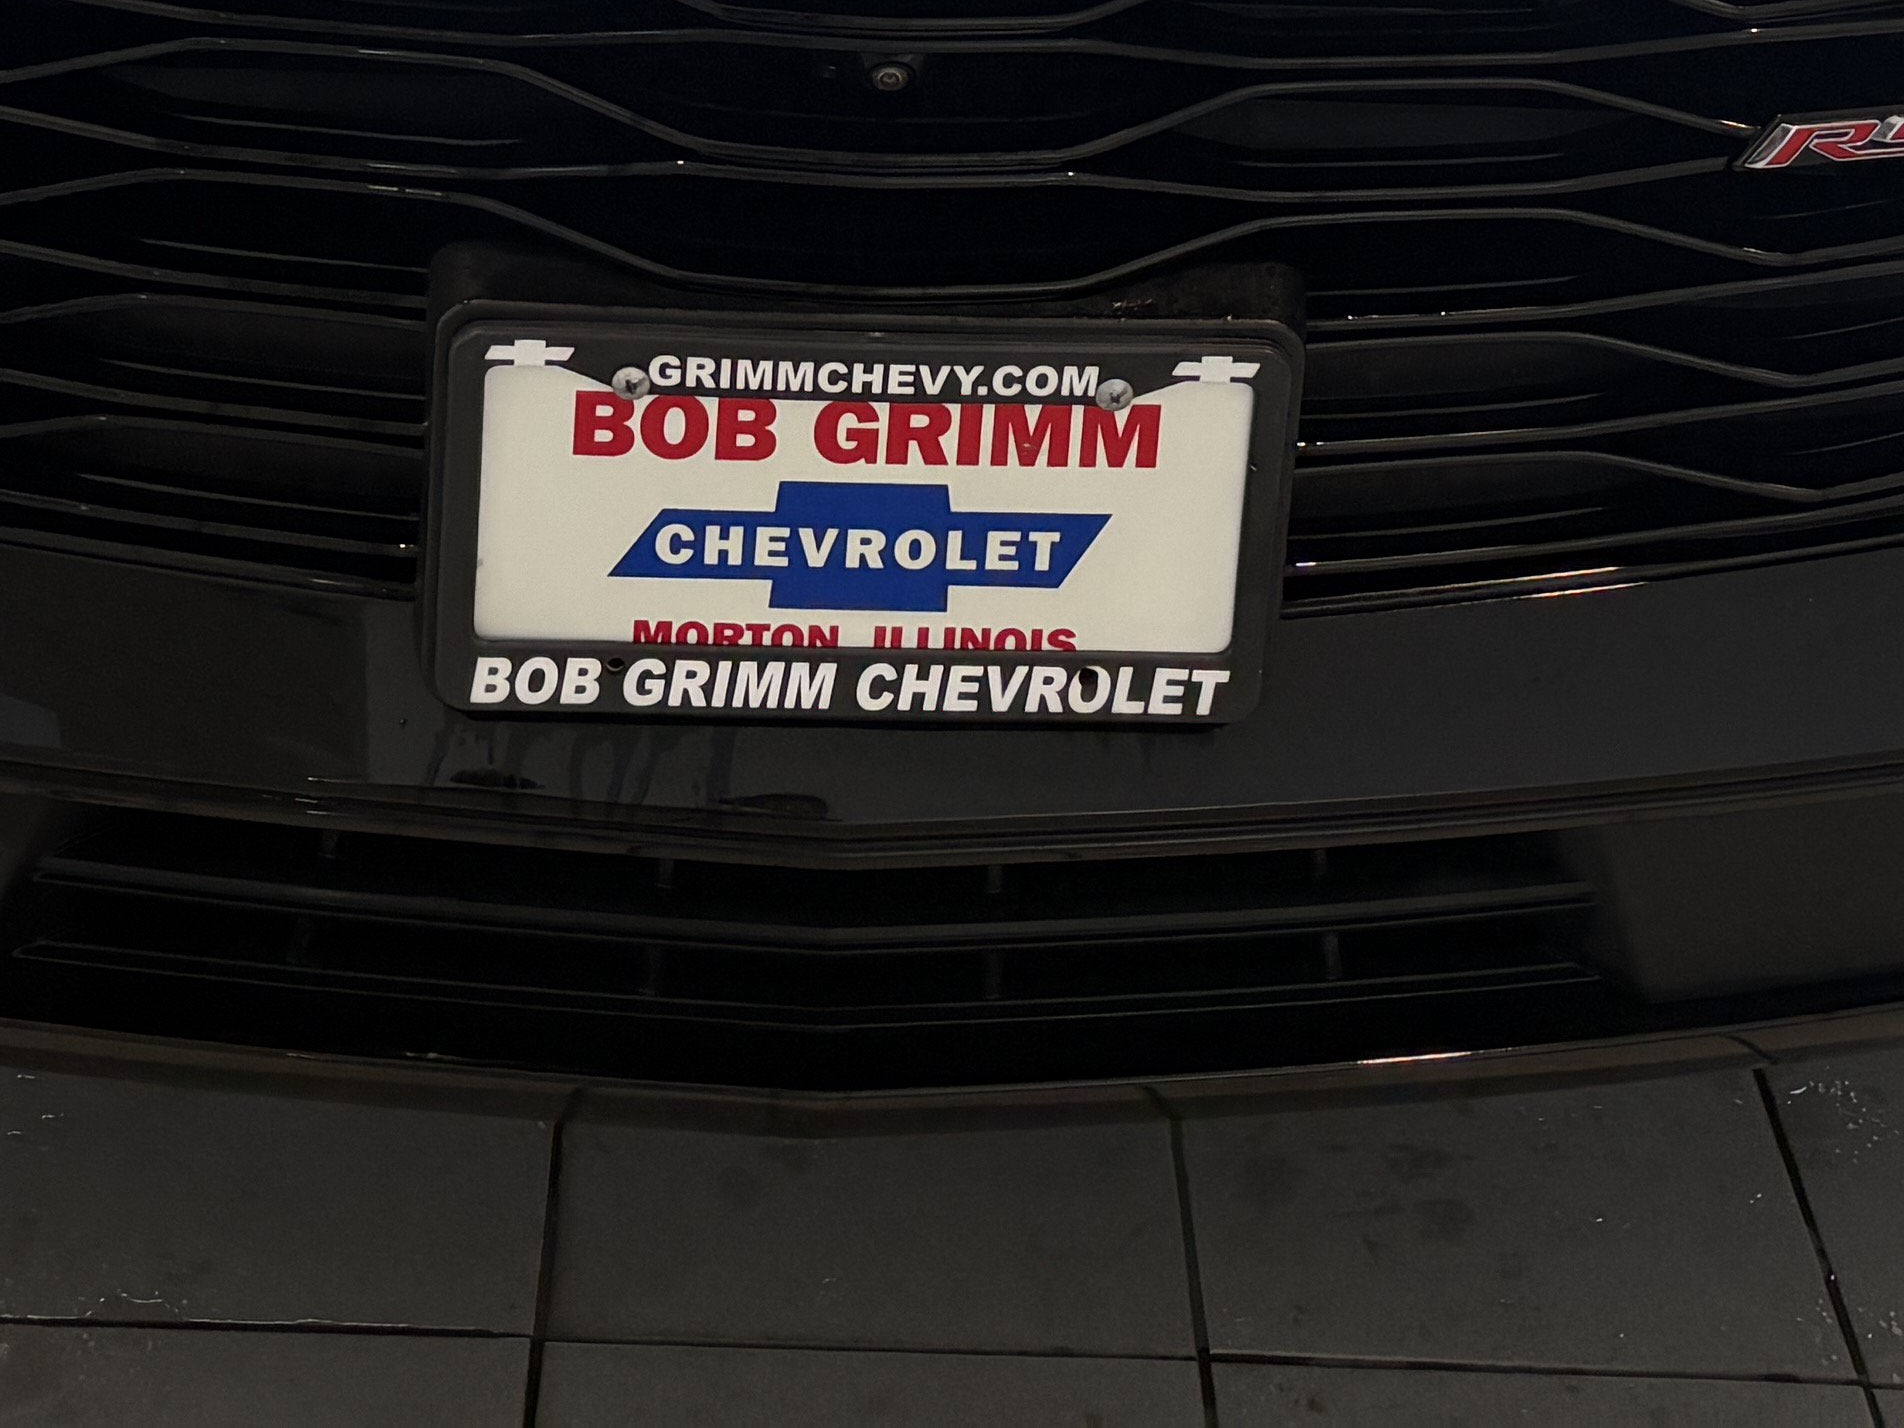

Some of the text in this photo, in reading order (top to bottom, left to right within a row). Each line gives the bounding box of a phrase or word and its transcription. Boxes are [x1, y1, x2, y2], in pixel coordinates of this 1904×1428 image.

[648, 354, 1100, 398] GRIMMCHEVY.COM
[572, 390, 1162, 469] BOB GRIMM
[654, 523, 1062, 572] CHEVROLET
[632, 619, 840, 648] MORTON
[469, 655, 1231, 716] BOB GRIMM CHEVROLET
